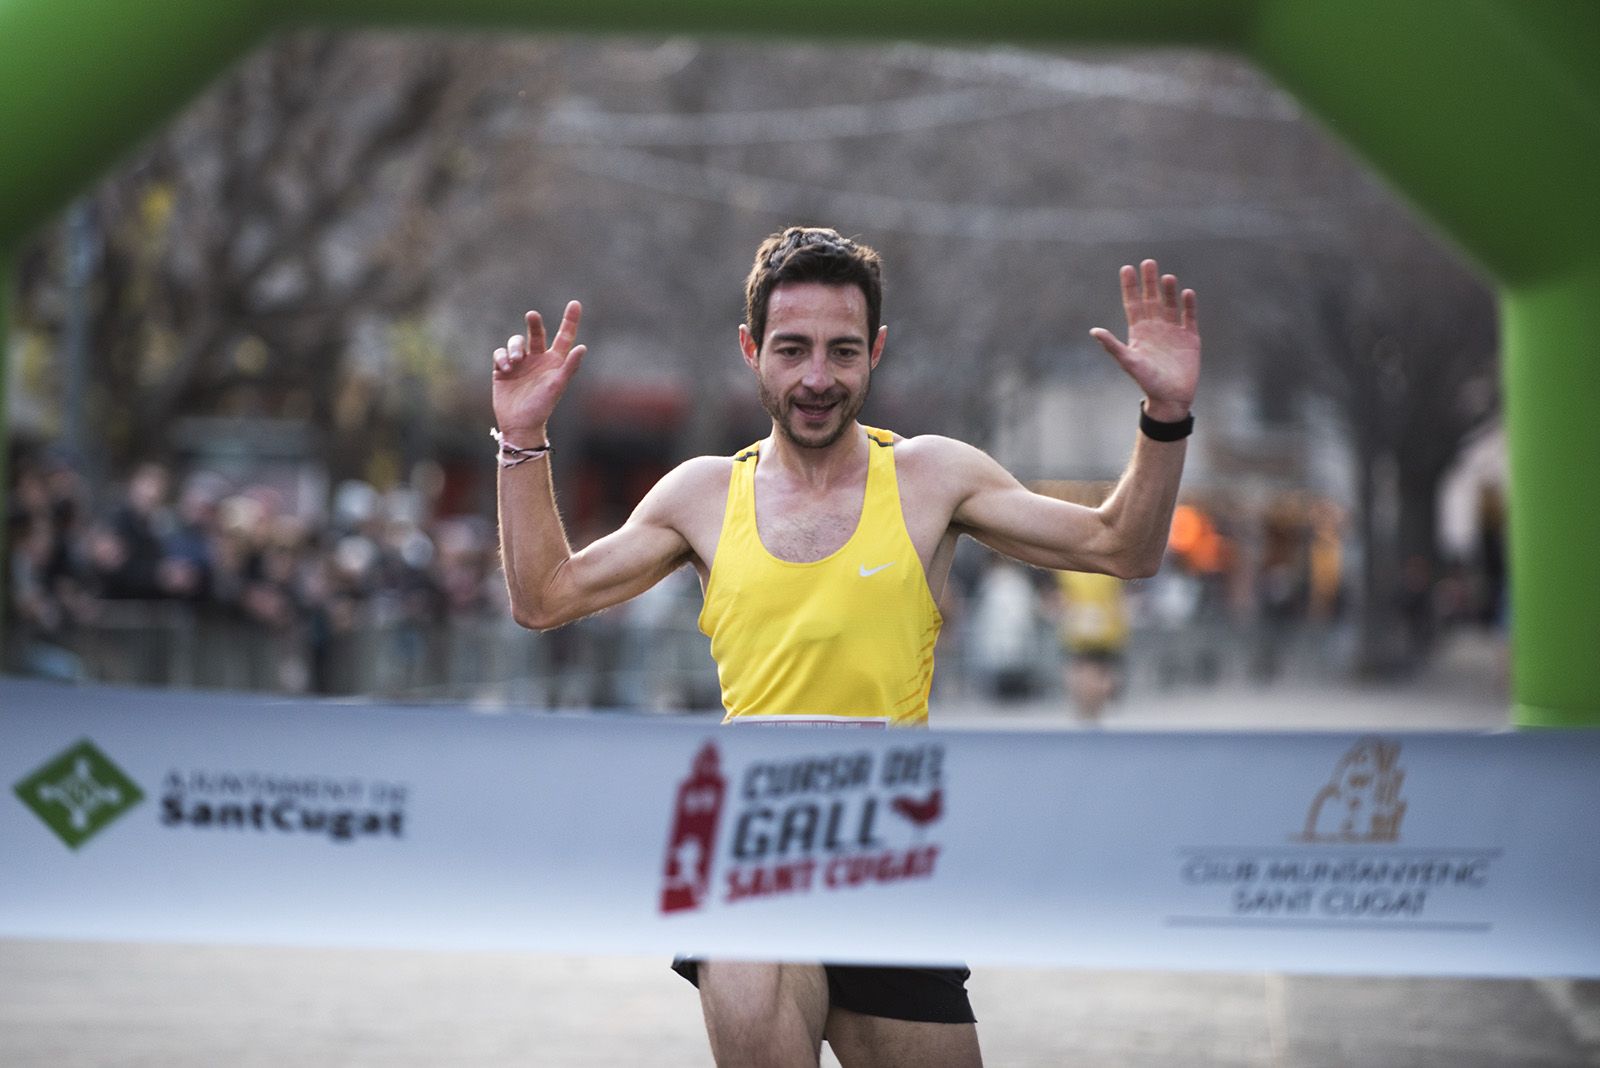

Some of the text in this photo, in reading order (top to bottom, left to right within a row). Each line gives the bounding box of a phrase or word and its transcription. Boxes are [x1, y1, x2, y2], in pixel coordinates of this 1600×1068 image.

[161, 795, 407, 841] SantCugat
[732, 797, 884, 859] GALL
[726, 845, 940, 901] SANT CUGAT
[1231, 887, 1428, 917] SANT CUGAT
